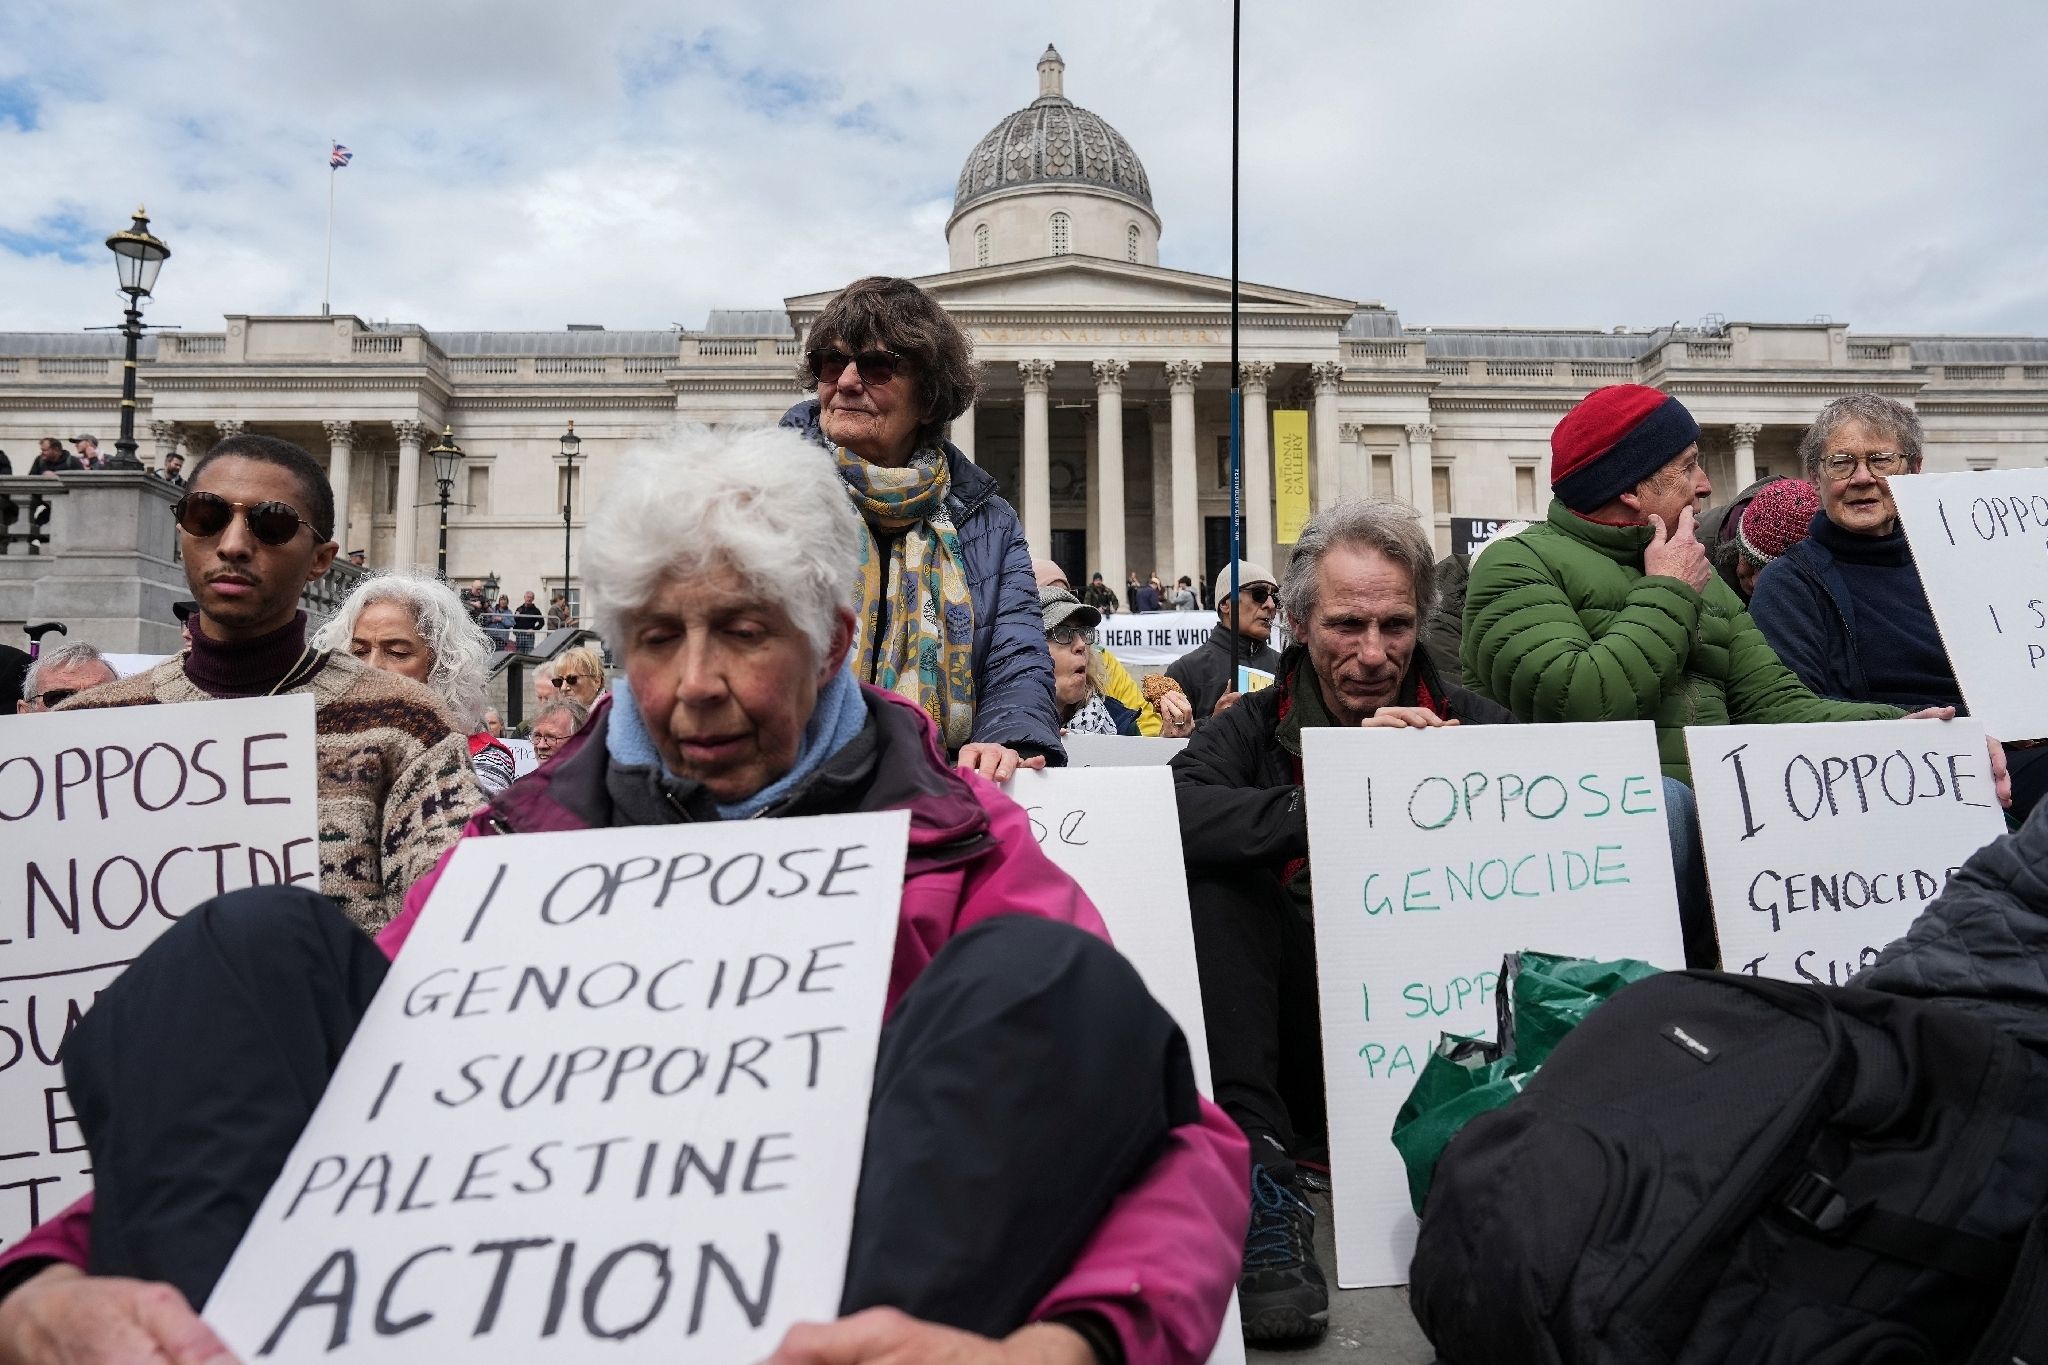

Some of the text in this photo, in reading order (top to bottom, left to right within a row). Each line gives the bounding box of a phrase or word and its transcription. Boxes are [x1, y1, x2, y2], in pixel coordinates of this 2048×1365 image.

[981, 328, 1224, 343] NATIONAL GALLERY
[1283, 433, 1292, 495] NATIONAL
[1293, 433, 1304, 495] GALLERY
[1938, 498, 1955, 545] I
[1106, 629, 1142, 646] HEAR
[1147, 629, 1172, 646] THE
[1177, 628, 1212, 645] WHO
[1988, 604, 2002, 634] I
[1366, 776, 1373, 828] I
[1408, 772, 1656, 830] OPPOSE
[1722, 744, 1991, 841] I OPPOSE
[463, 845, 871, 942] I OPPOSE
[1364, 845, 1630, 915] GENOCIDE
[402, 941, 856, 1019] GENOCIDE
[1362, 971, 1500, 1021] I SUPP
[367, 1027, 846, 1121] I SUPPORT
[283, 1133, 796, 1220] PALESTINE
[255, 1233, 781, 1356] ACTION
